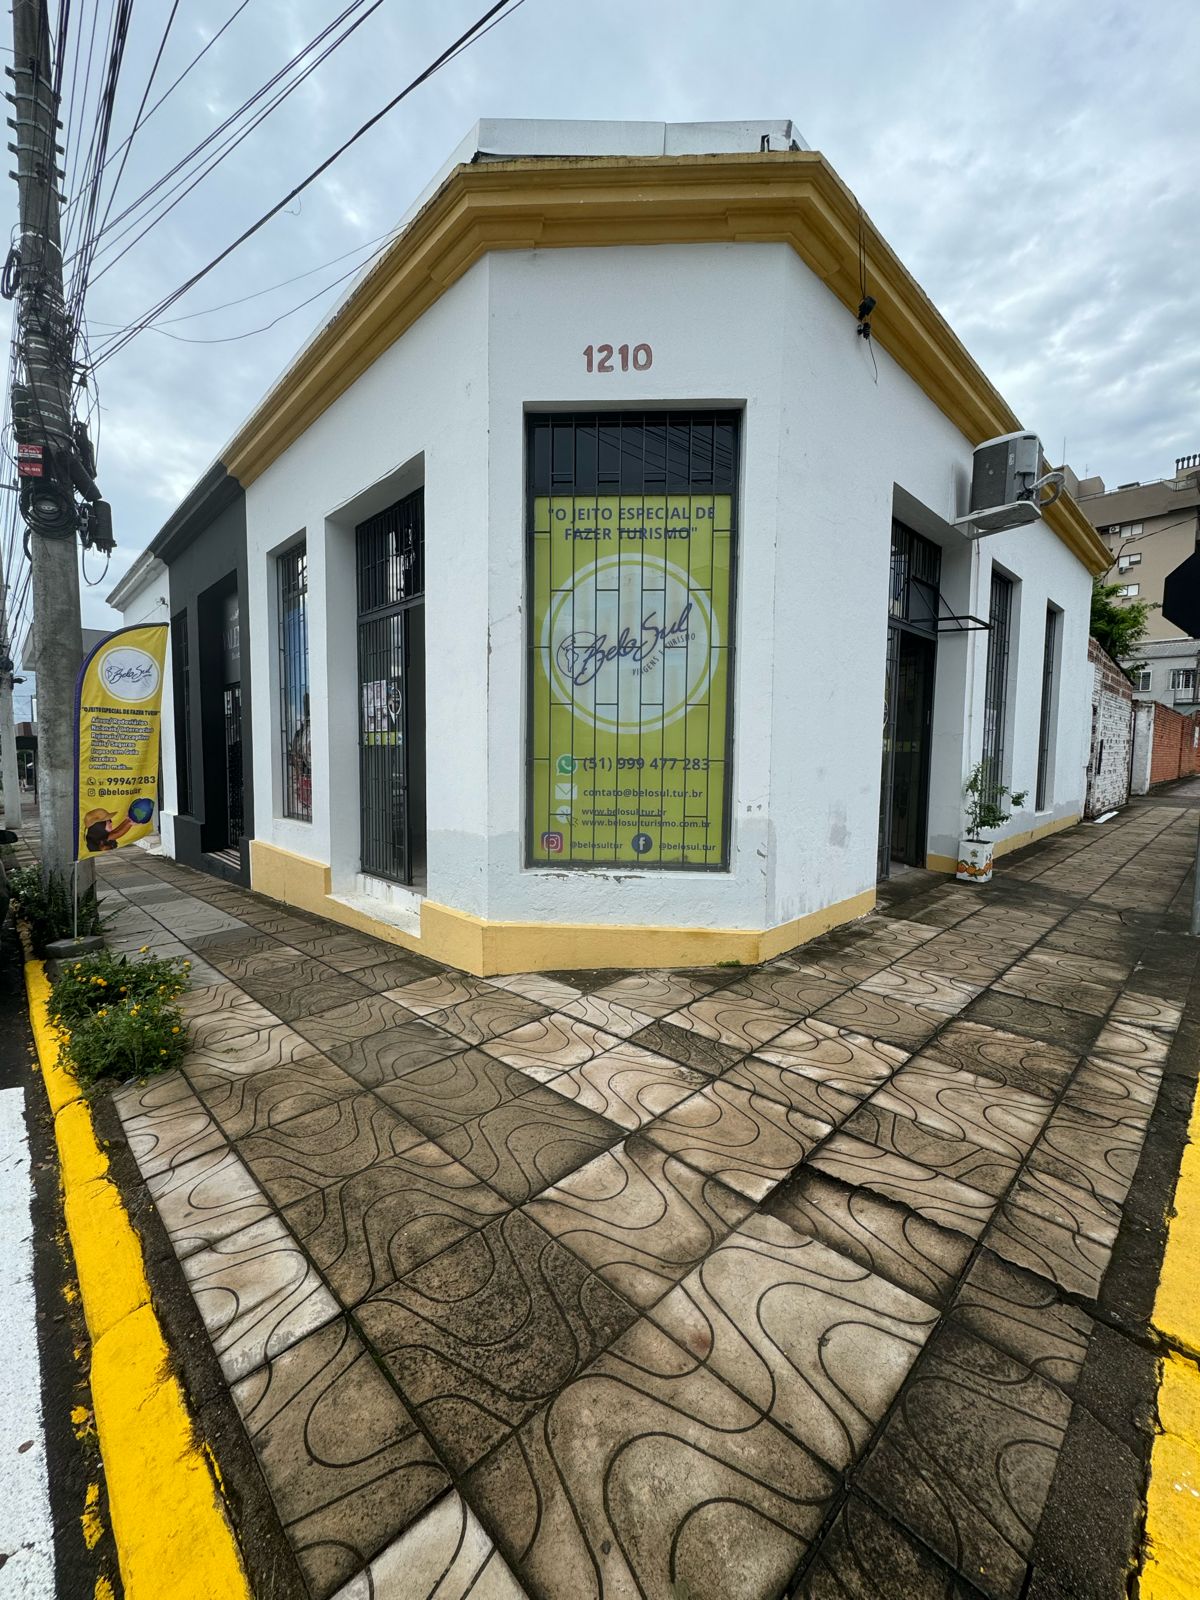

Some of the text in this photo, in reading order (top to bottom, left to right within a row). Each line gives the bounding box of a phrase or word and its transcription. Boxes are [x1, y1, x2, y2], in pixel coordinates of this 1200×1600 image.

[583, 343, 653, 373] 1210
[571, 508, 613, 523] JEITO
[619, 507, 690, 521] ESPECIAL
[695, 506, 715, 519] DE
[564, 528, 612, 541] FAZER
[632, 656, 660, 676] VIGENS
[583, 757, 710, 771] (51) 999 477 283
[583, 788, 703, 798] contato@belosul.tur.br
